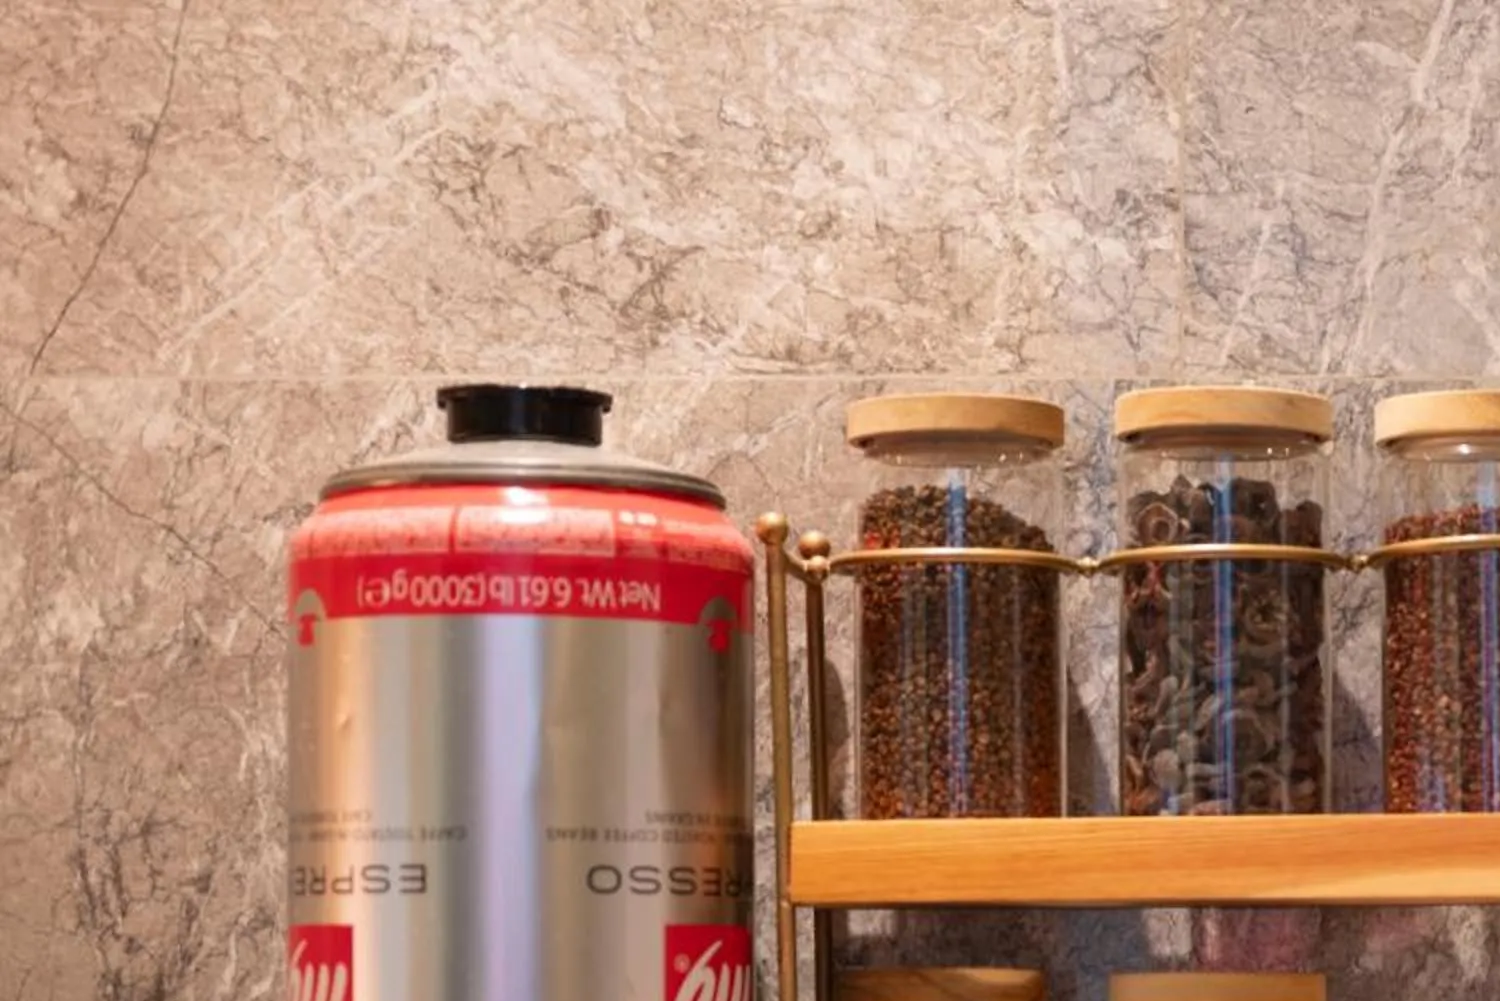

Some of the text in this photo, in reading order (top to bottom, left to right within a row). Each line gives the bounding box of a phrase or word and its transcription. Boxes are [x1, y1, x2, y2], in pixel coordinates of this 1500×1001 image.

[490, 576, 515, 607] lb
[518, 575, 573, 607] 6.61
[575, 577, 617, 608] Wt.
[619, 580, 662, 611] Net
